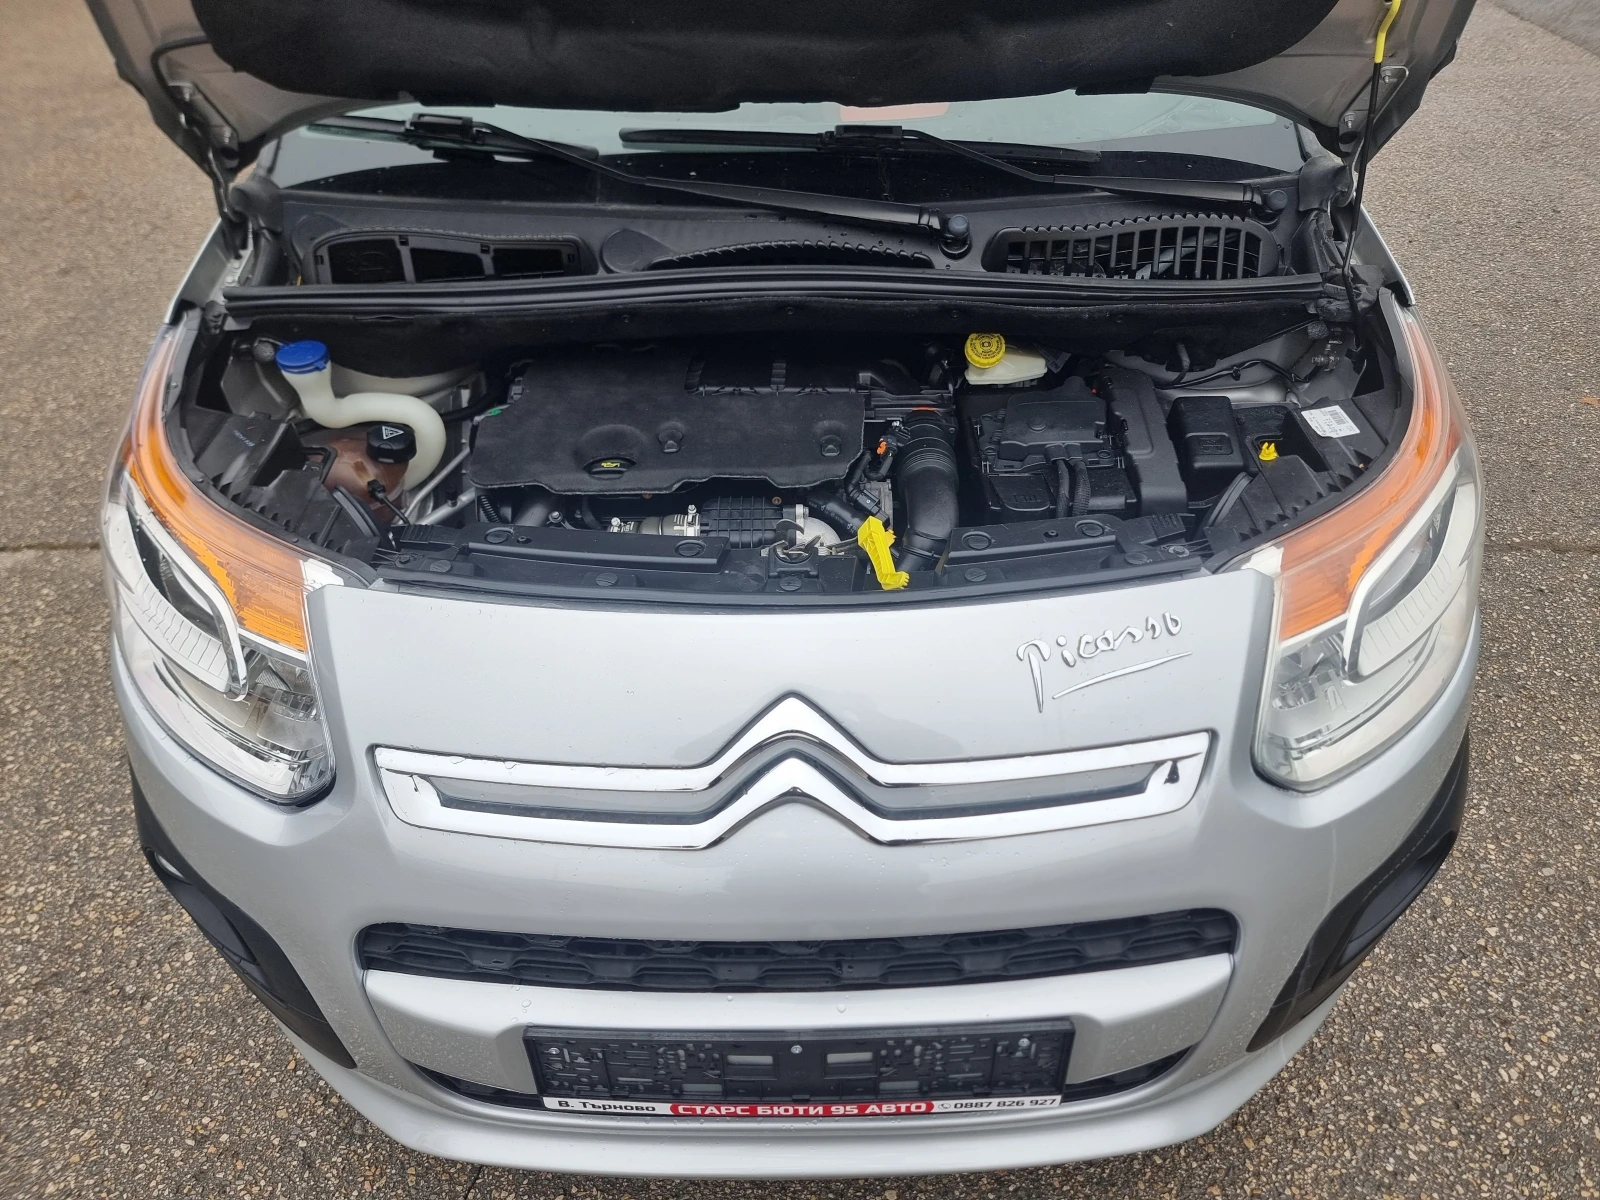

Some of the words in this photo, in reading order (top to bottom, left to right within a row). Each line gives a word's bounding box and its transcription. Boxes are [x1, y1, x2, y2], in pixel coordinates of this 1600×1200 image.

[1016, 611, 1183, 713] Picasso
[579, 1101, 656, 1112] Търново
[678, 1105, 750, 1116] СТАРС
[756, 1106, 823, 1116] БЮТИ
[830, 1105, 859, 1115] 95
[864, 1103, 927, 1113] АВТО
[953, 1101, 993, 1110] 0887
[996, 1100, 1026, 1108] 826
[1029, 1098, 1057, 1107] 927
